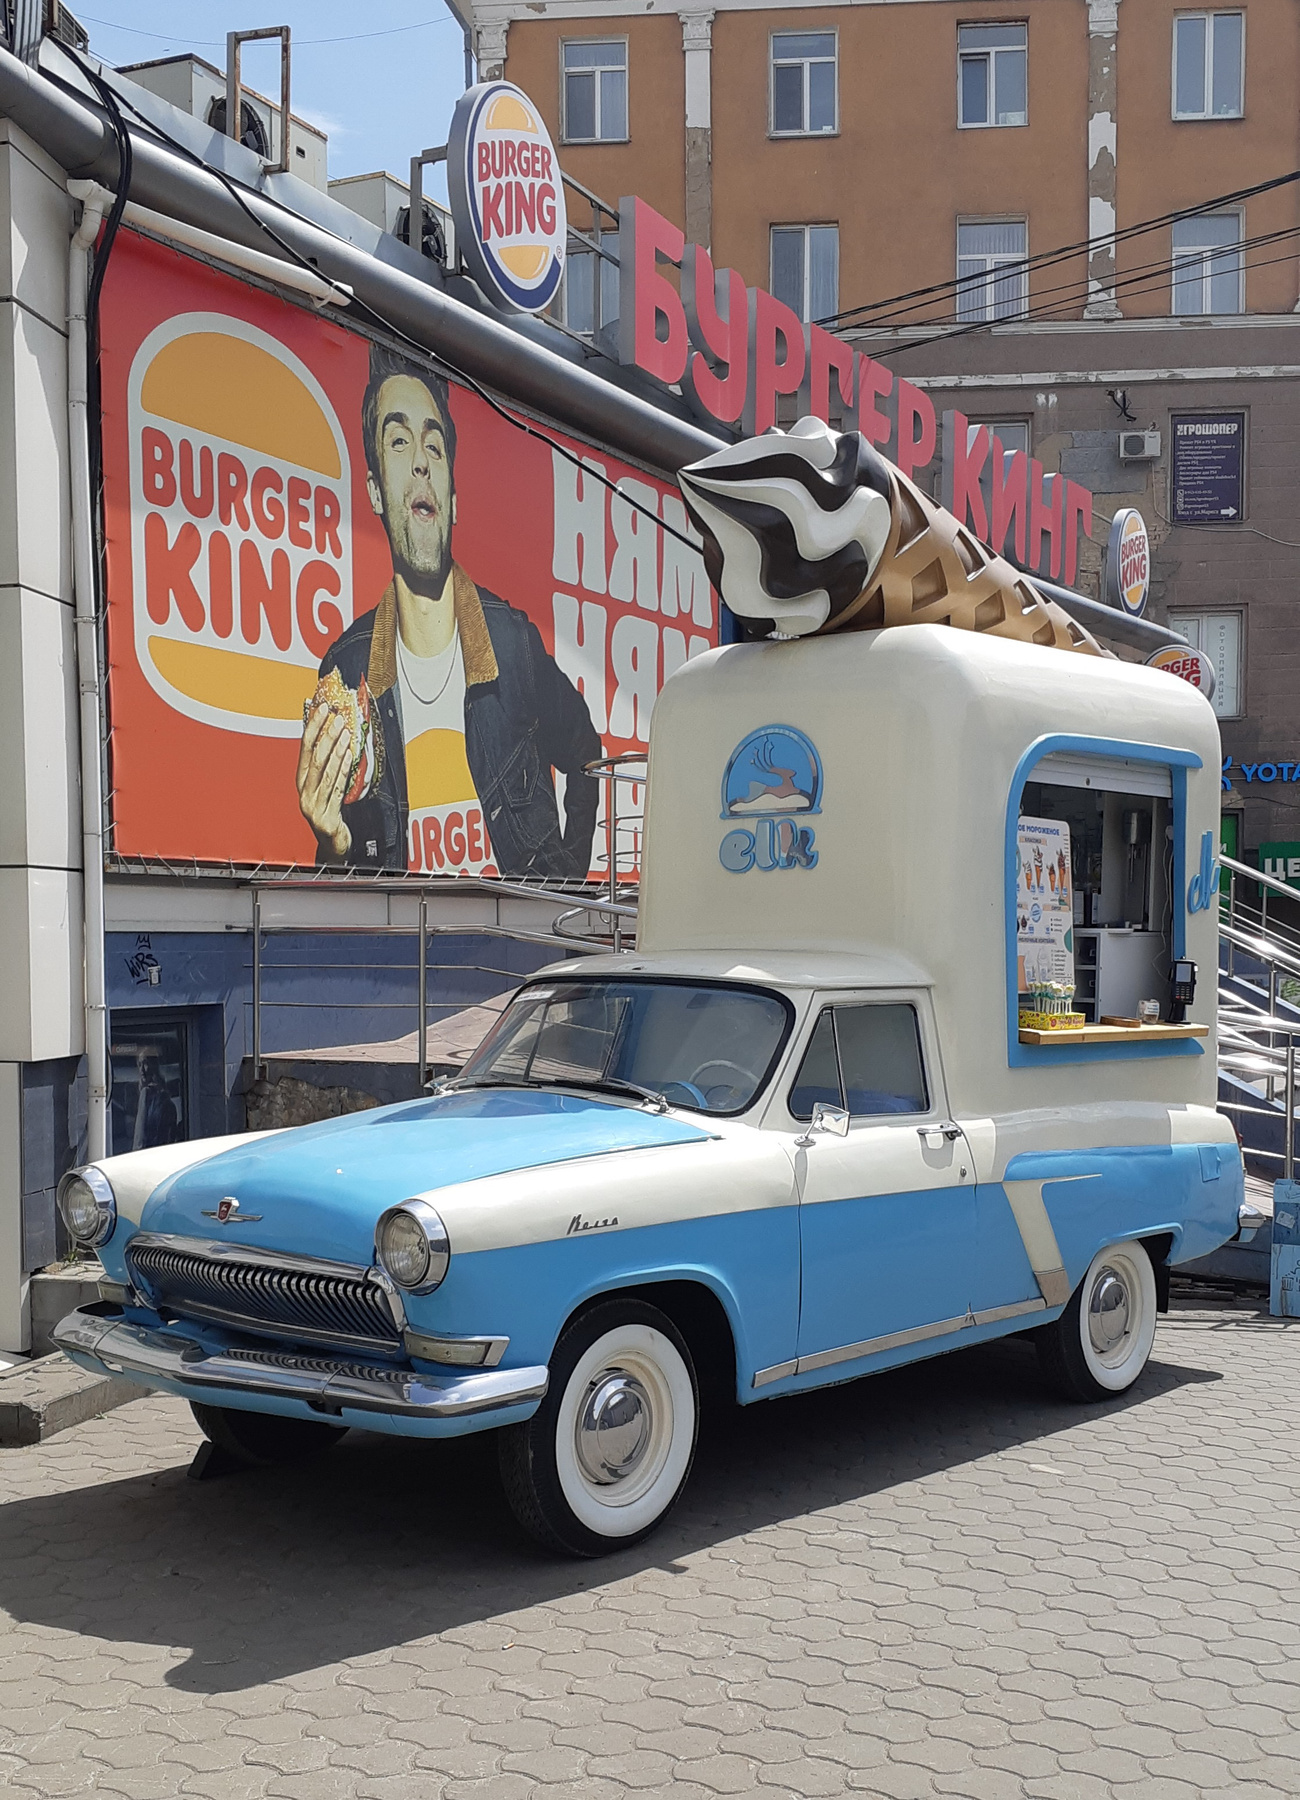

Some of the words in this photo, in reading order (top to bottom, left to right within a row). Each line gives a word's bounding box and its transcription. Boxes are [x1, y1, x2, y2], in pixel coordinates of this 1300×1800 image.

[478, 140, 553, 182] BURGER
[482, 181, 556, 243] KING
[619, 195, 936, 480] БУРГЕР
[942, 409, 1093, 587] КИНГ
[141, 426, 343, 560] BURGER
[552, 446, 713, 630] НЯМ
[1121, 534, 1146, 565] BURGER
[144, 511, 345, 661] KING
[1120, 553, 1147, 593] KING
[1157, 657, 1200, 674] RGER
[1218, 625, 1226, 707] ФОТОЭПИЛЯЦИЯ
[719, 819, 819, 873] elk
[1026, 825, 1060, 836] МОРОЖЕНОЕ
